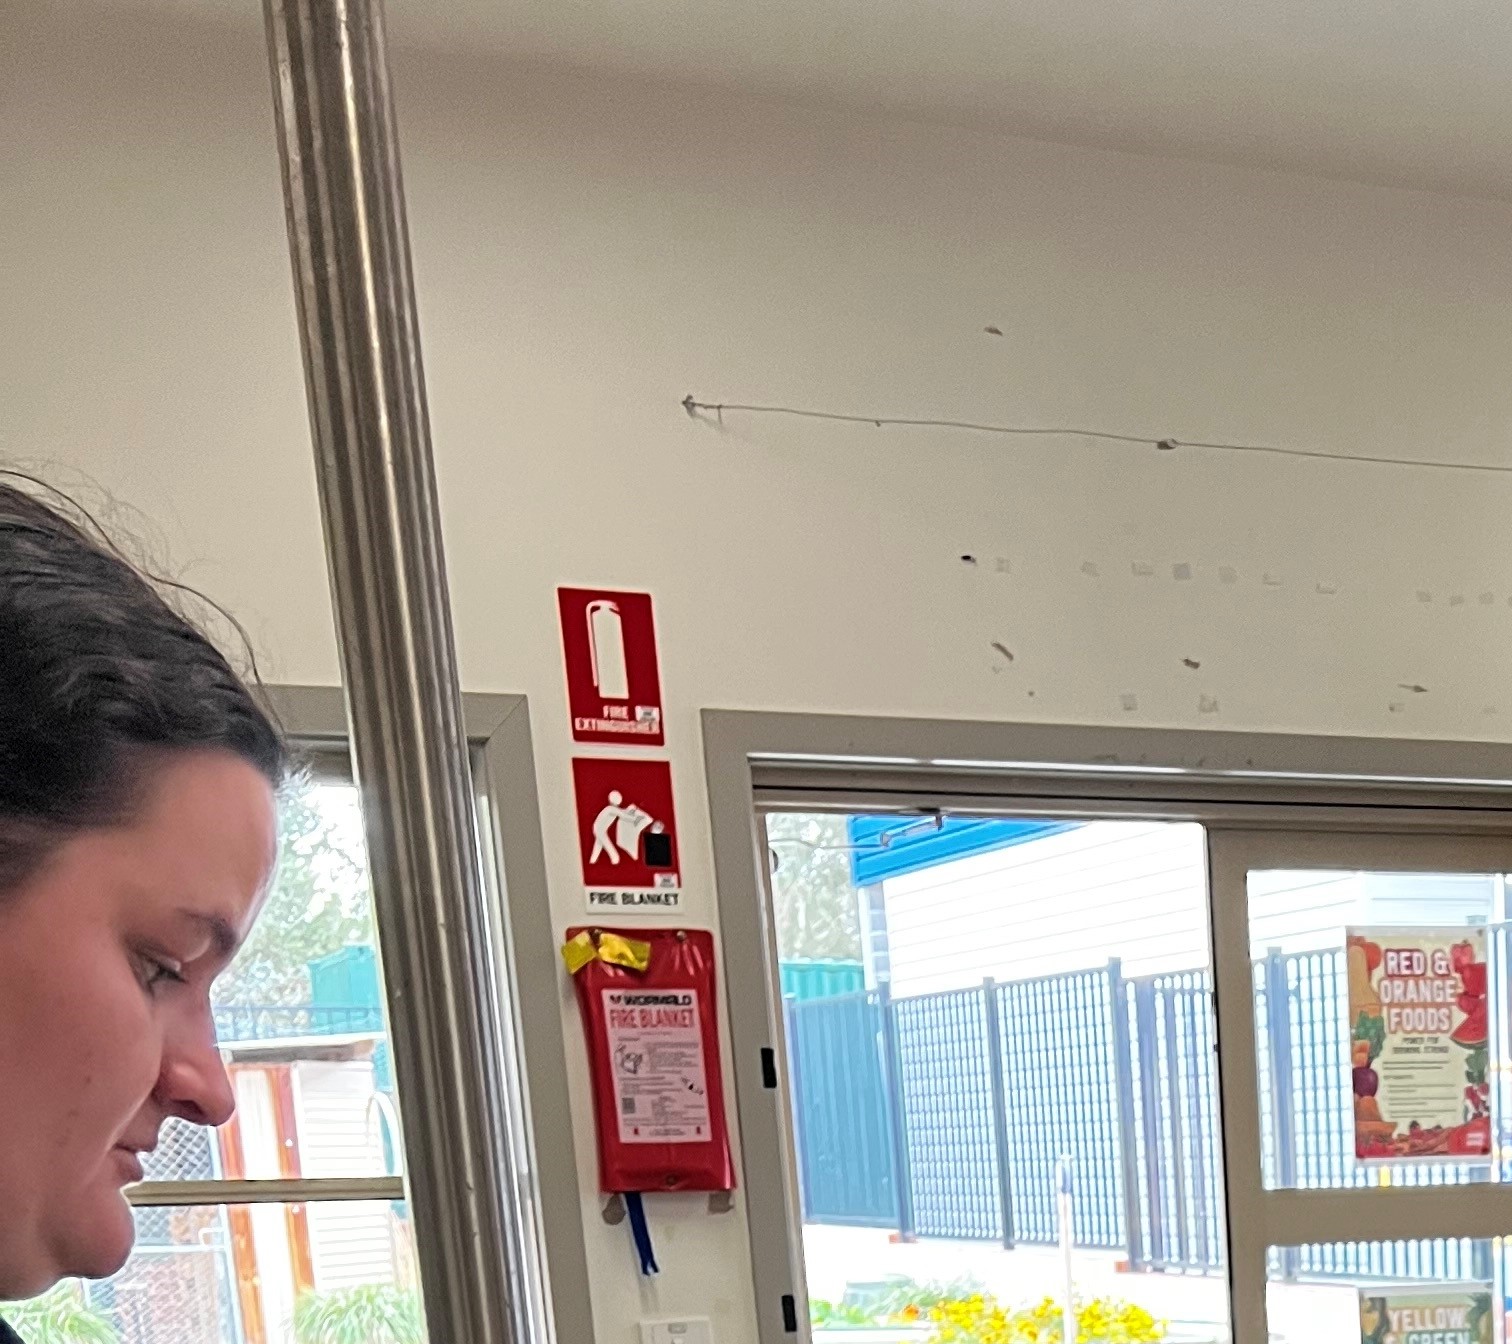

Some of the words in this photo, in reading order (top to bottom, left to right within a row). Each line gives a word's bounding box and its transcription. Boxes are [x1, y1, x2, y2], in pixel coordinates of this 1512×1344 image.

[589, 892, 618, 905] FIRE
[621, 892, 679, 906] BLANKET
[1386, 950, 1425, 976] RED
[1433, 951, 1451, 975] &
[1380, 979, 1457, 1004] ORANGE
[610, 1008, 637, 1028] FIRE
[640, 1008, 695, 1028] BLANKET
[1389, 1007, 1451, 1032] FOODS
[1388, 1307, 1466, 1332] YELLOW
